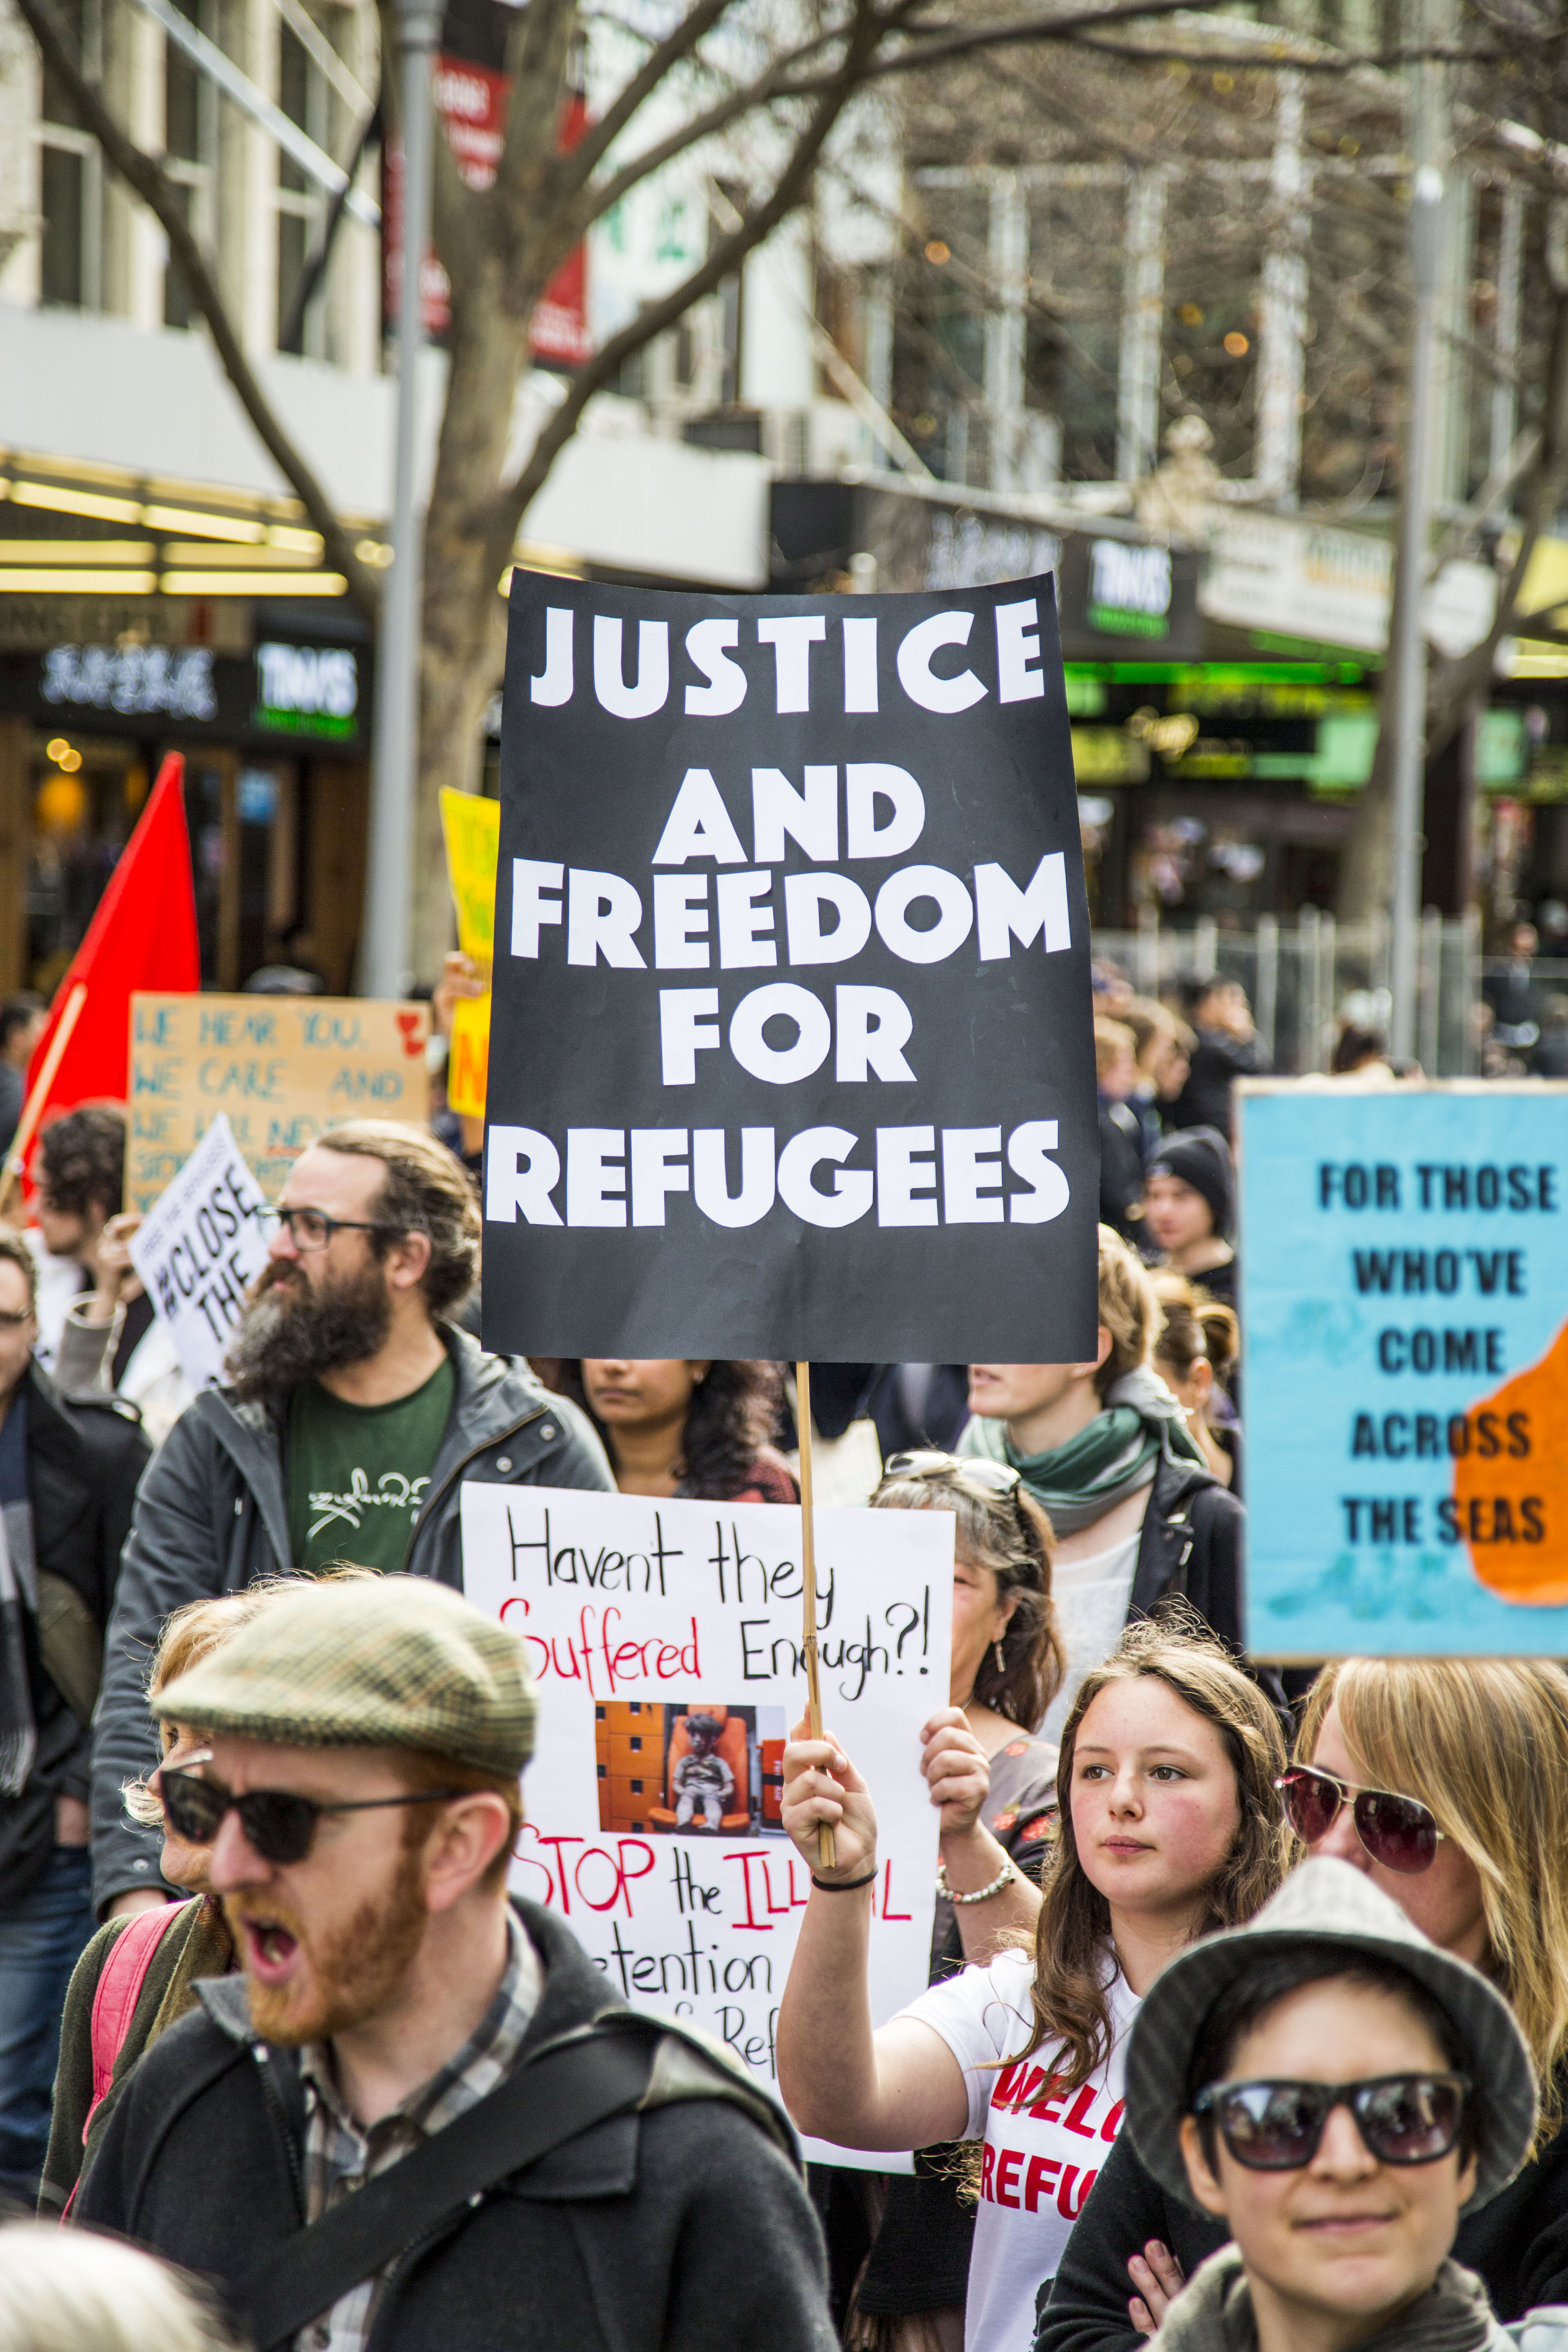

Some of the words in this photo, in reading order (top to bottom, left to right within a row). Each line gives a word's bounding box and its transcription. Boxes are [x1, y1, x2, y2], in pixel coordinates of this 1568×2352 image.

[531, 598, 1045, 719] JUSTICE
[652, 762, 925, 864] AND
[511, 851, 1071, 969] FREEDOM
[135, 1006, 180, 1050] WE
[198, 1008, 278, 1049] HEAR
[659, 982, 917, 1085] FOR
[134, 1057, 185, 1099] WE
[198, 1058, 287, 1103] CARE
[329, 1066, 404, 1102] AND
[486, 1120, 1070, 1227] REFUGEES
[1318, 1163, 1401, 1210] FOR
[1418, 1163, 1559, 1212] THOSE
[156, 1164, 253, 1320] #CLOSE
[1352, 1248, 1528, 1296] WHO'VE
[199, 1250, 249, 1343] THE
[1378, 1328, 1505, 1376] COME
[1352, 1412, 1531, 1460] ACROSS
[507, 1505, 684, 1596] Havent
[708, 1521, 834, 1630] they
[1343, 1497, 1422, 1544] THE
[1437, 1497, 1545, 1544] SEAS
[499, 1598, 702, 1699] Suffered
[512, 1822, 656, 1918] STOP
[670, 1846, 722, 1915] the
[723, 1851, 912, 1930] ILLL
